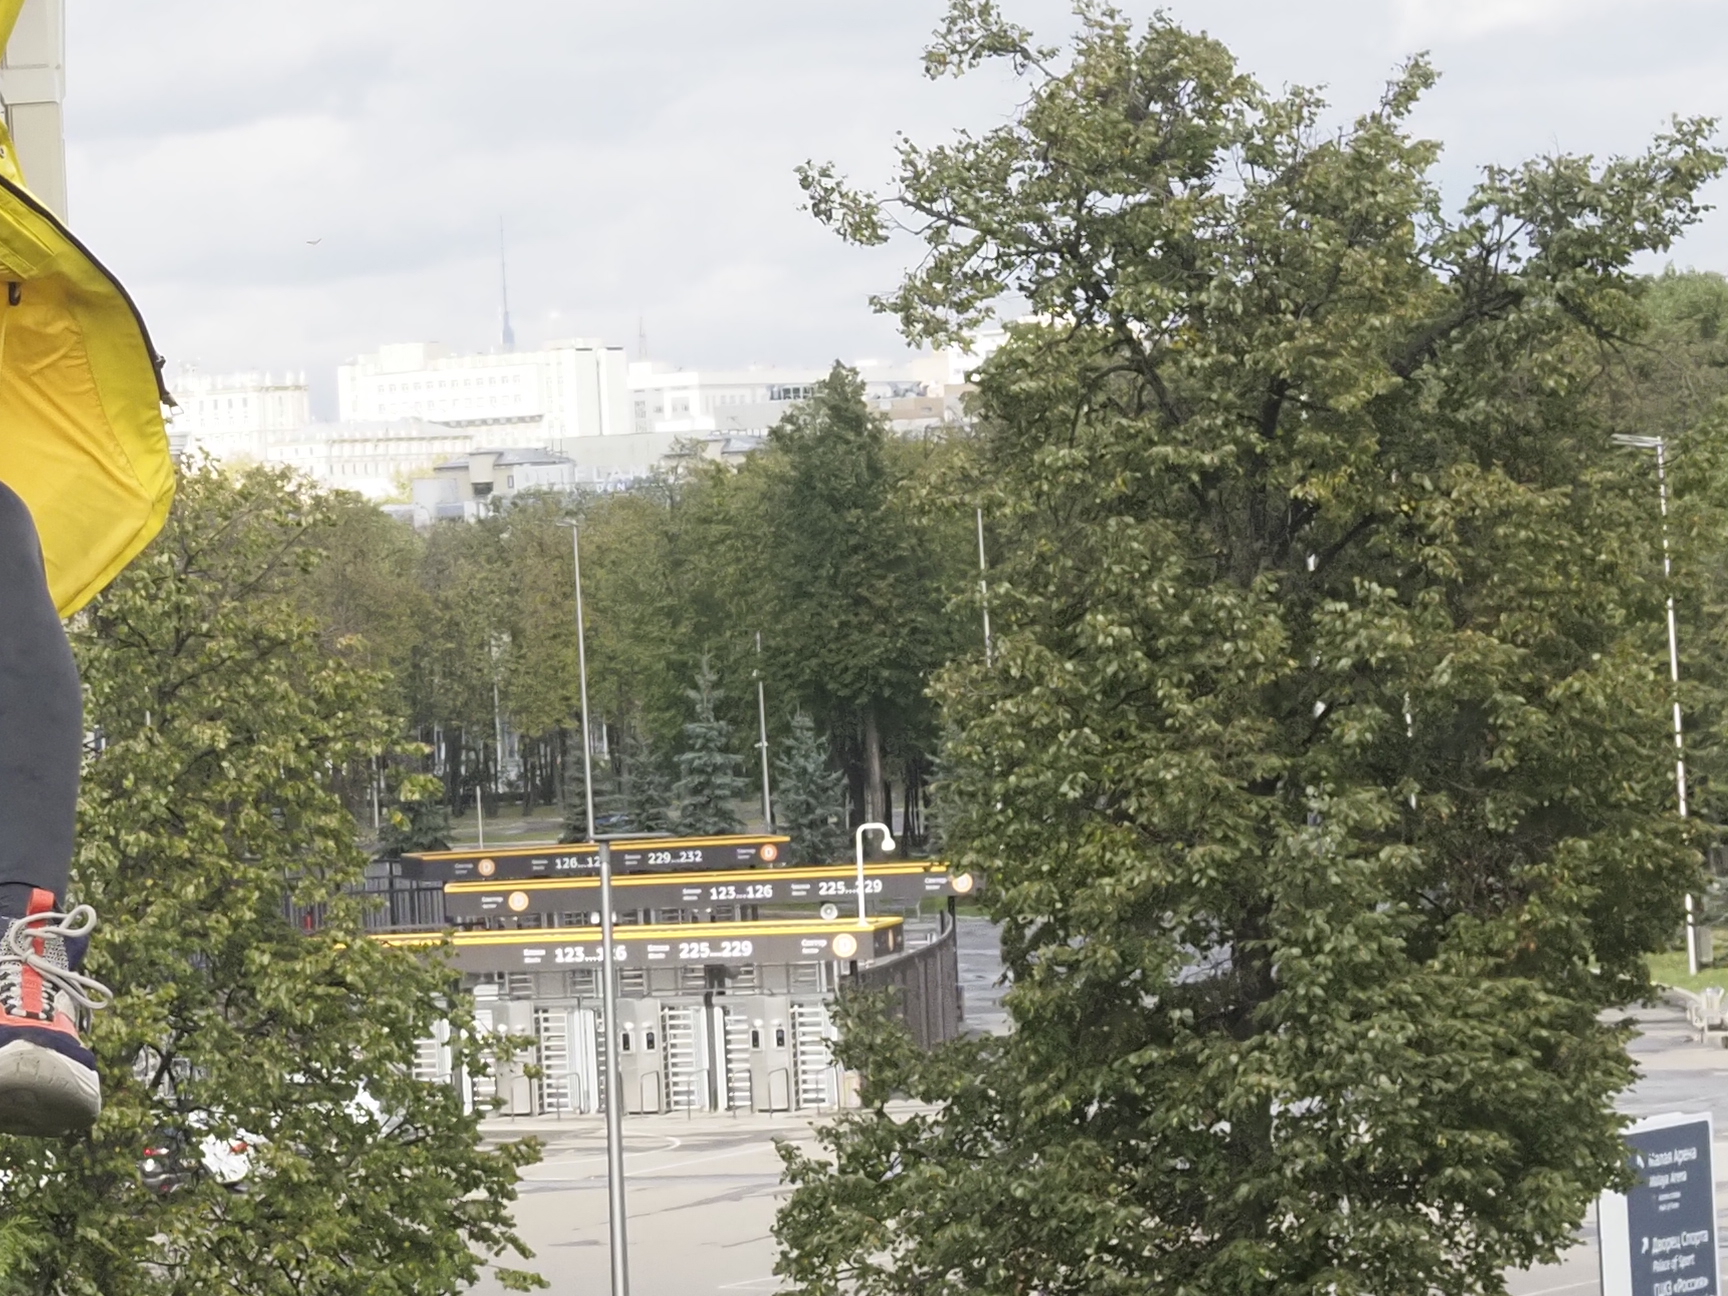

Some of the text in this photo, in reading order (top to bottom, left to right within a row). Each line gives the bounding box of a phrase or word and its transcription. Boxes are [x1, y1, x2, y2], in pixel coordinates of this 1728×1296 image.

[555, 856, 601, 870] 126...12
[555, 945, 628, 963] 123...16
[1674, 1147, 1697, 1166] Арена
